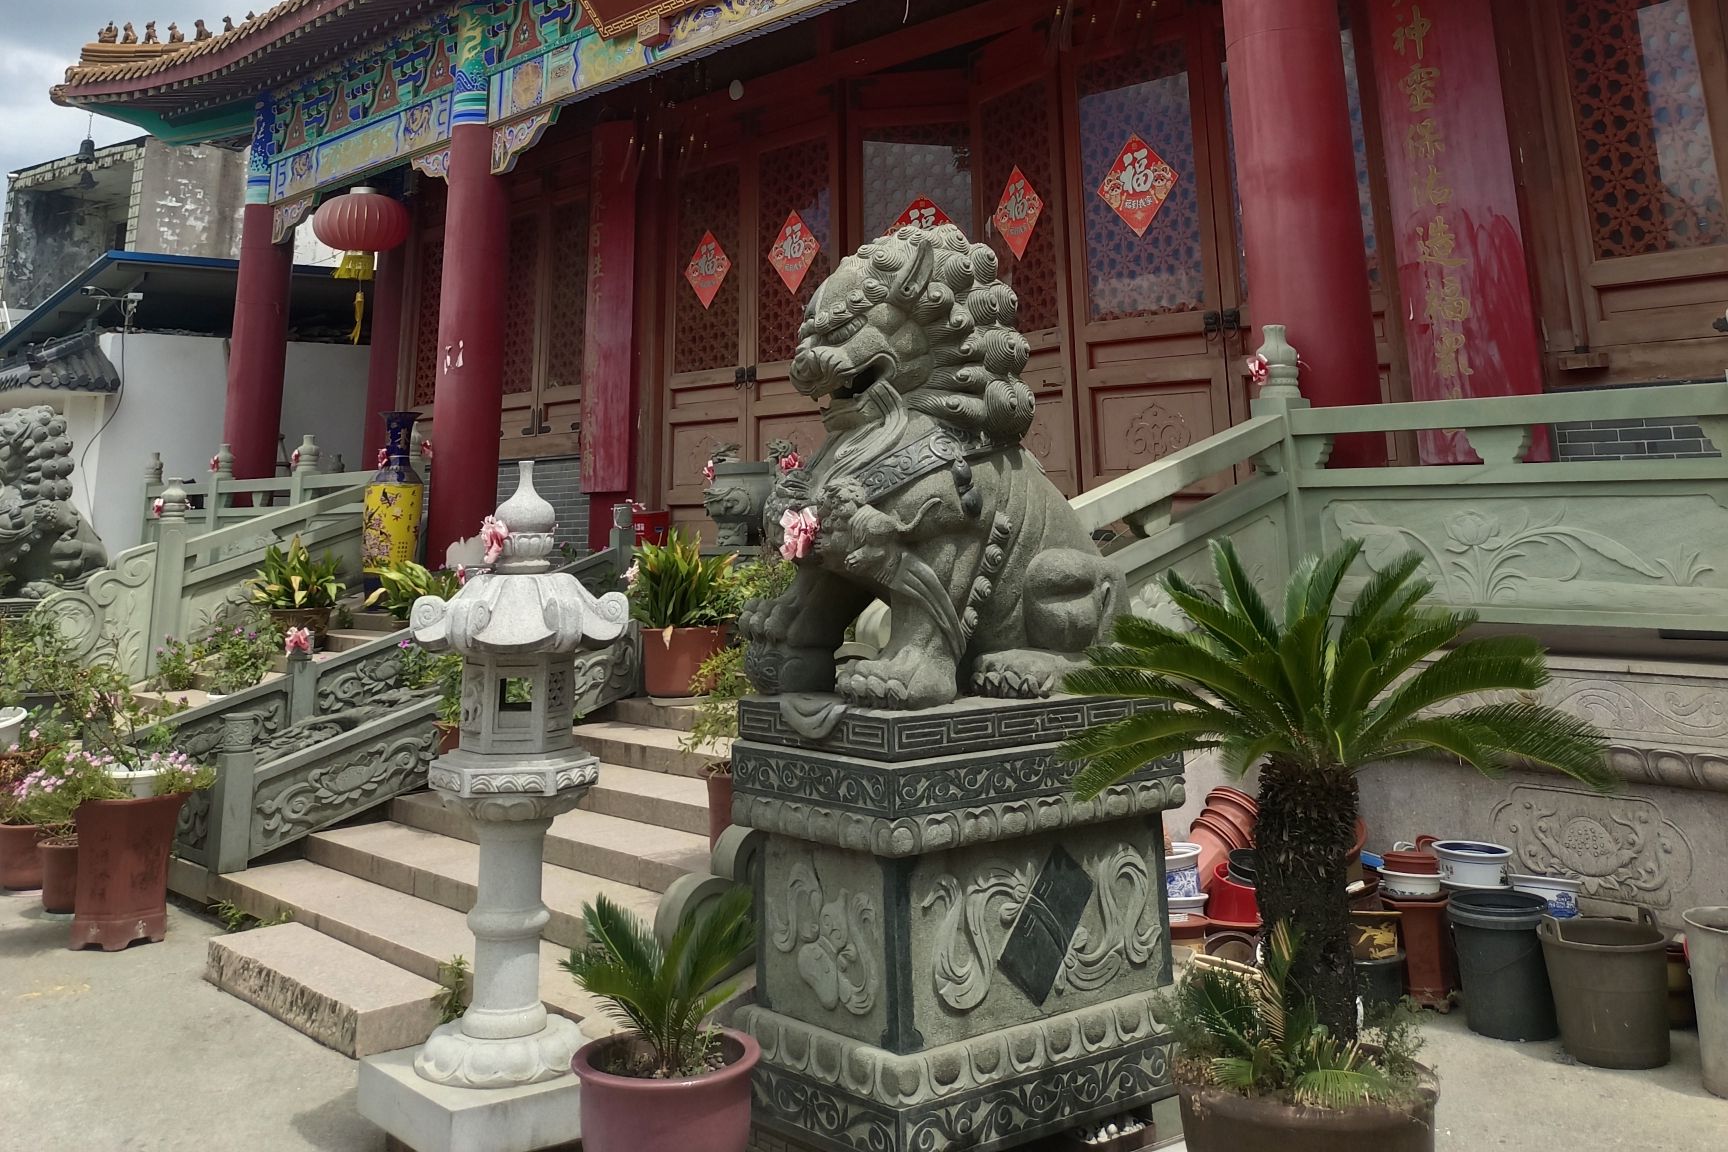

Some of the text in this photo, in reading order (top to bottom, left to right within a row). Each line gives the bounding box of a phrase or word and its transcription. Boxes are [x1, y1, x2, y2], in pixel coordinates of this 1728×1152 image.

[1119, 148, 1154, 194] 福
[1006, 179, 1028, 221] 福
[698, 241, 717, 276] 福
[783, 222, 805, 259] 福
